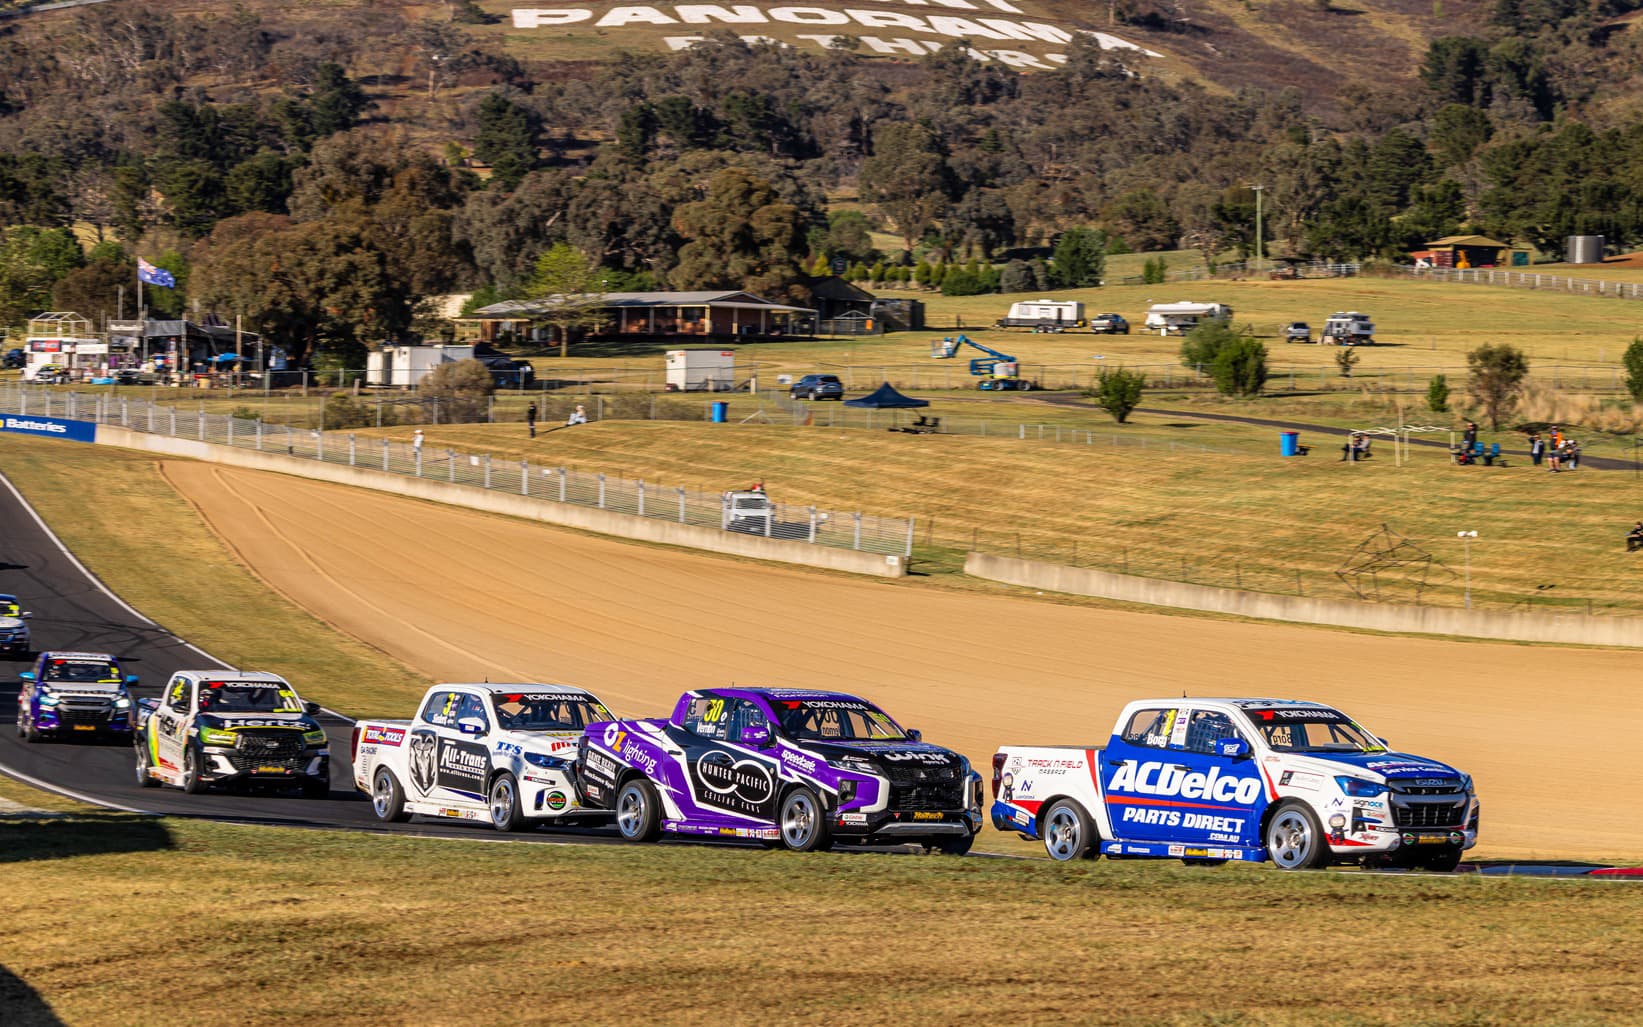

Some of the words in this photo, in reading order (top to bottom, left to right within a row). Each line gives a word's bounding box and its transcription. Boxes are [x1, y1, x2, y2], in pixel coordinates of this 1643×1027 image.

[512, 5, 1165, 58] PANORAMA
[6, 418, 67, 433] Batteries
[524, 693, 588, 702] YOKOHAMA
[802, 701, 869, 710] YOKOHAMA
[1275, 710, 1340, 719] YOKOHAMA
[496, 741, 522, 755] TFS
[1147, 733, 1168, 748] Borg
[440, 745, 487, 769] All-Trans
[623, 739, 657, 774] lighting
[1028, 759, 1053, 768] TRACK
[702, 762, 732, 780] HUNTER
[736, 772, 767, 791] PACIFIC
[1108, 759, 1261, 804] ACDelco
[1122, 807, 1181, 826] PARTS
[1182, 814, 1245, 836] DIRECT
